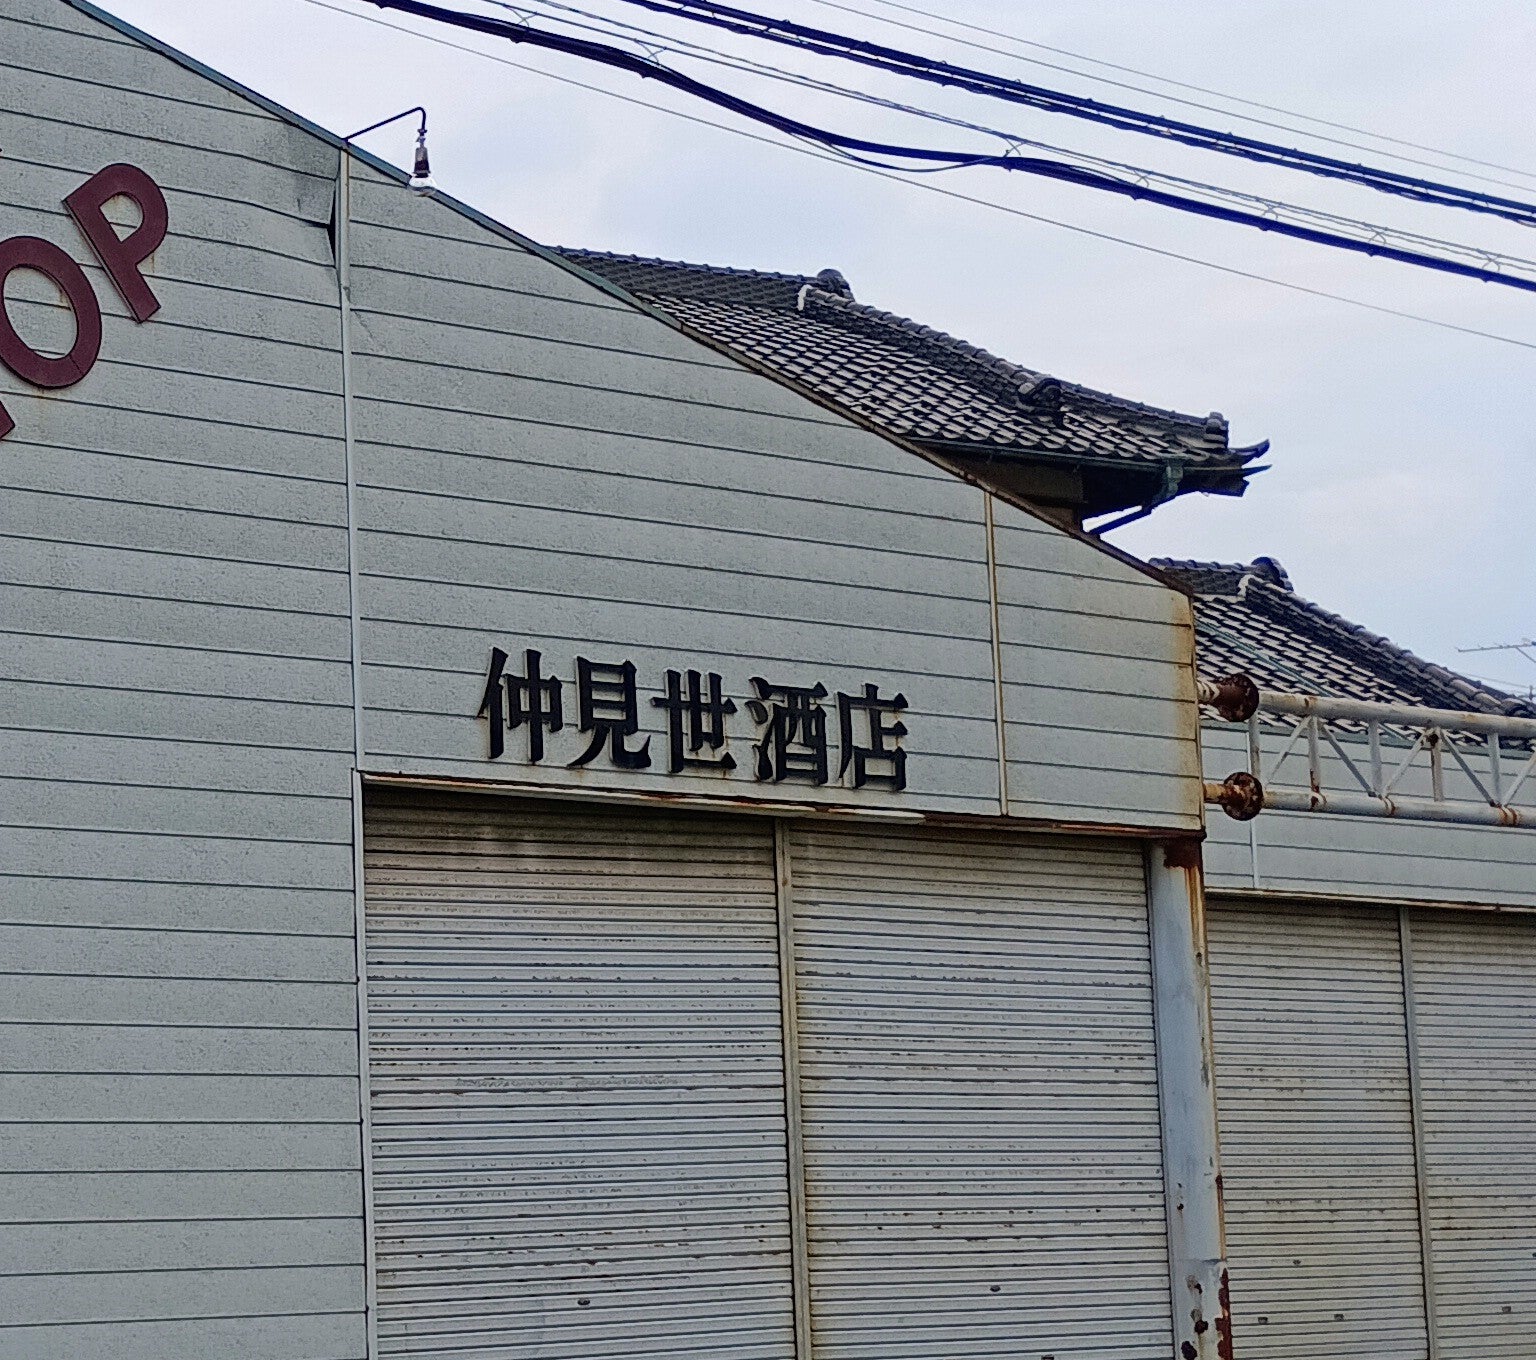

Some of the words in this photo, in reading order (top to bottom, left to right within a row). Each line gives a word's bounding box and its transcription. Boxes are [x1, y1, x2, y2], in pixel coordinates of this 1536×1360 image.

[478, 647, 910, 791] 仲見世酒店
